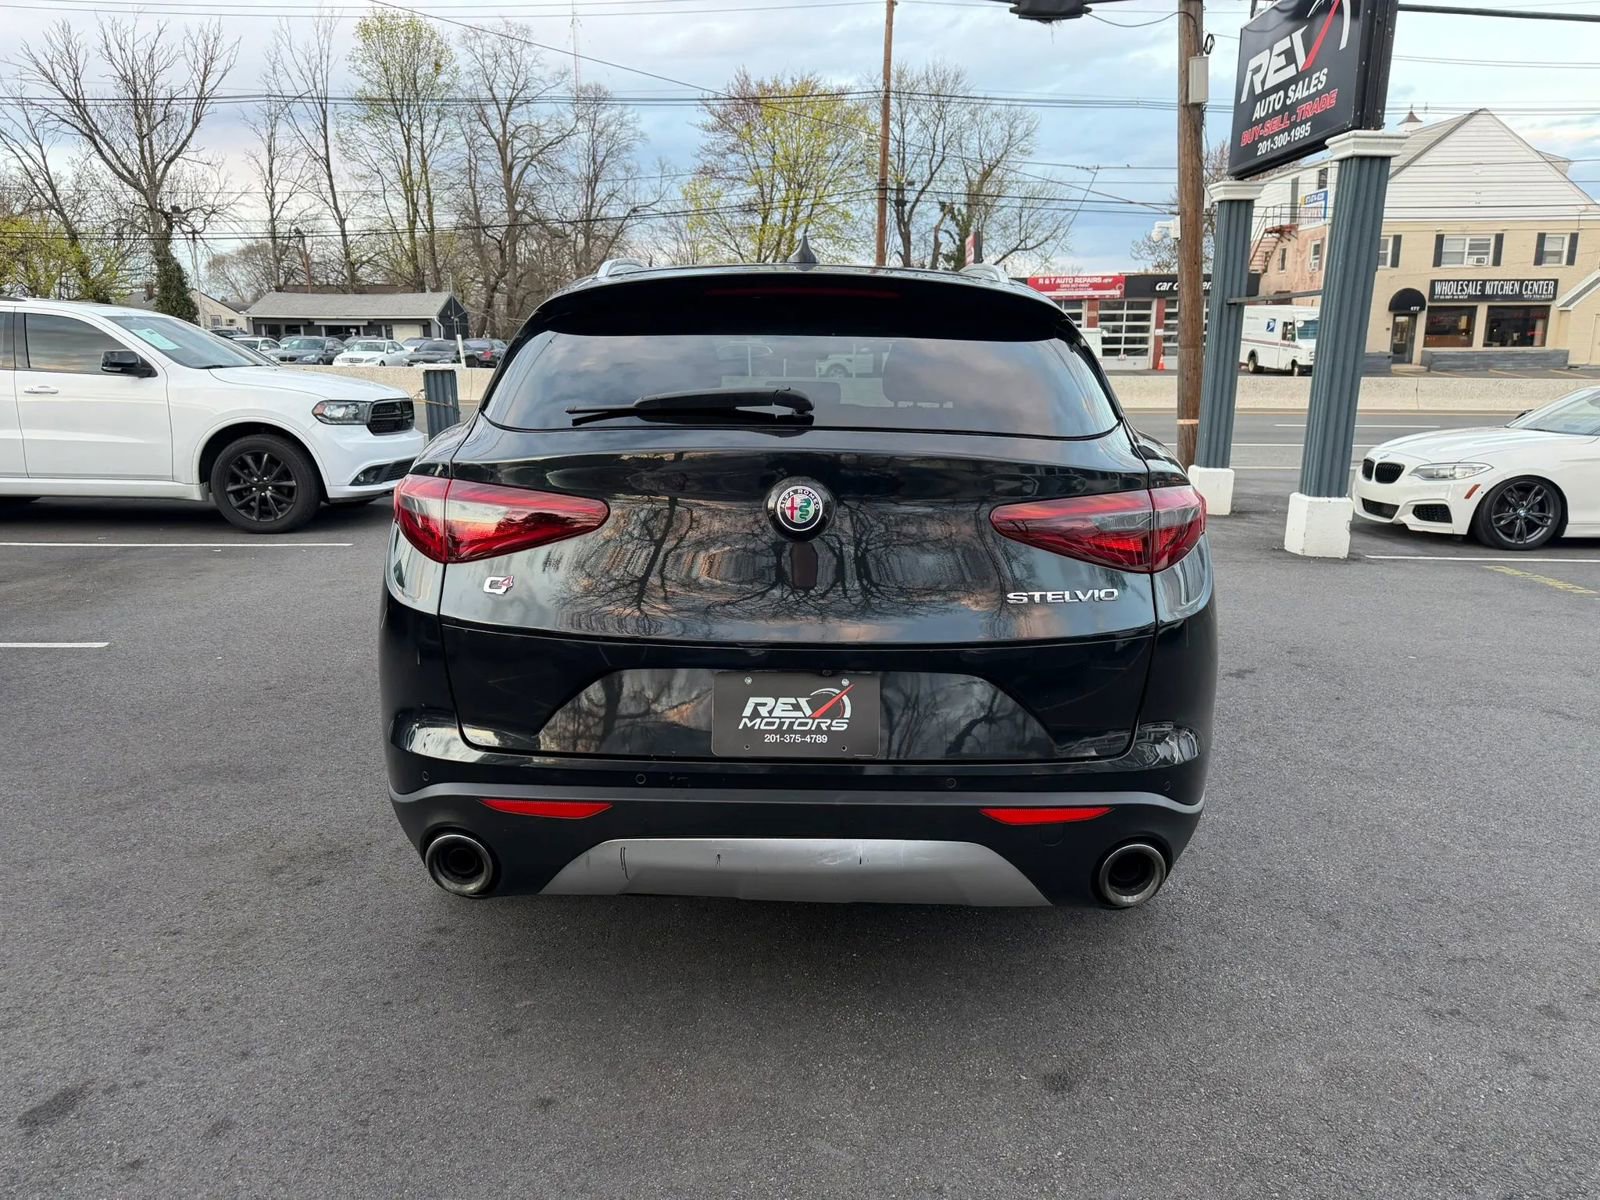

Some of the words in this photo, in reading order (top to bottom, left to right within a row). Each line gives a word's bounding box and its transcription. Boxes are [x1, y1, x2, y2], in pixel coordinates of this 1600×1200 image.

[1252, 93, 1284, 121] AUTO
[1285, 67, 1329, 106] SALES
[1256, 122, 1312, 156] 201-300-1995
[1074, 276, 1102, 284] REPAIRS
[1434, 280, 1483, 295] WHOLESALE
[1484, 280, 1521, 295] KITCHEN
[1522, 280, 1555, 295] CENTER
[780, 491, 795, 508] ALFA
[797, 488, 820, 510] ROMEO
[1006, 588, 1119, 604] STELVIO
[742, 690, 836, 718] REV
[738, 718, 849, 731] MOTORS
[764, 734, 828, 744] 201-375-4789
